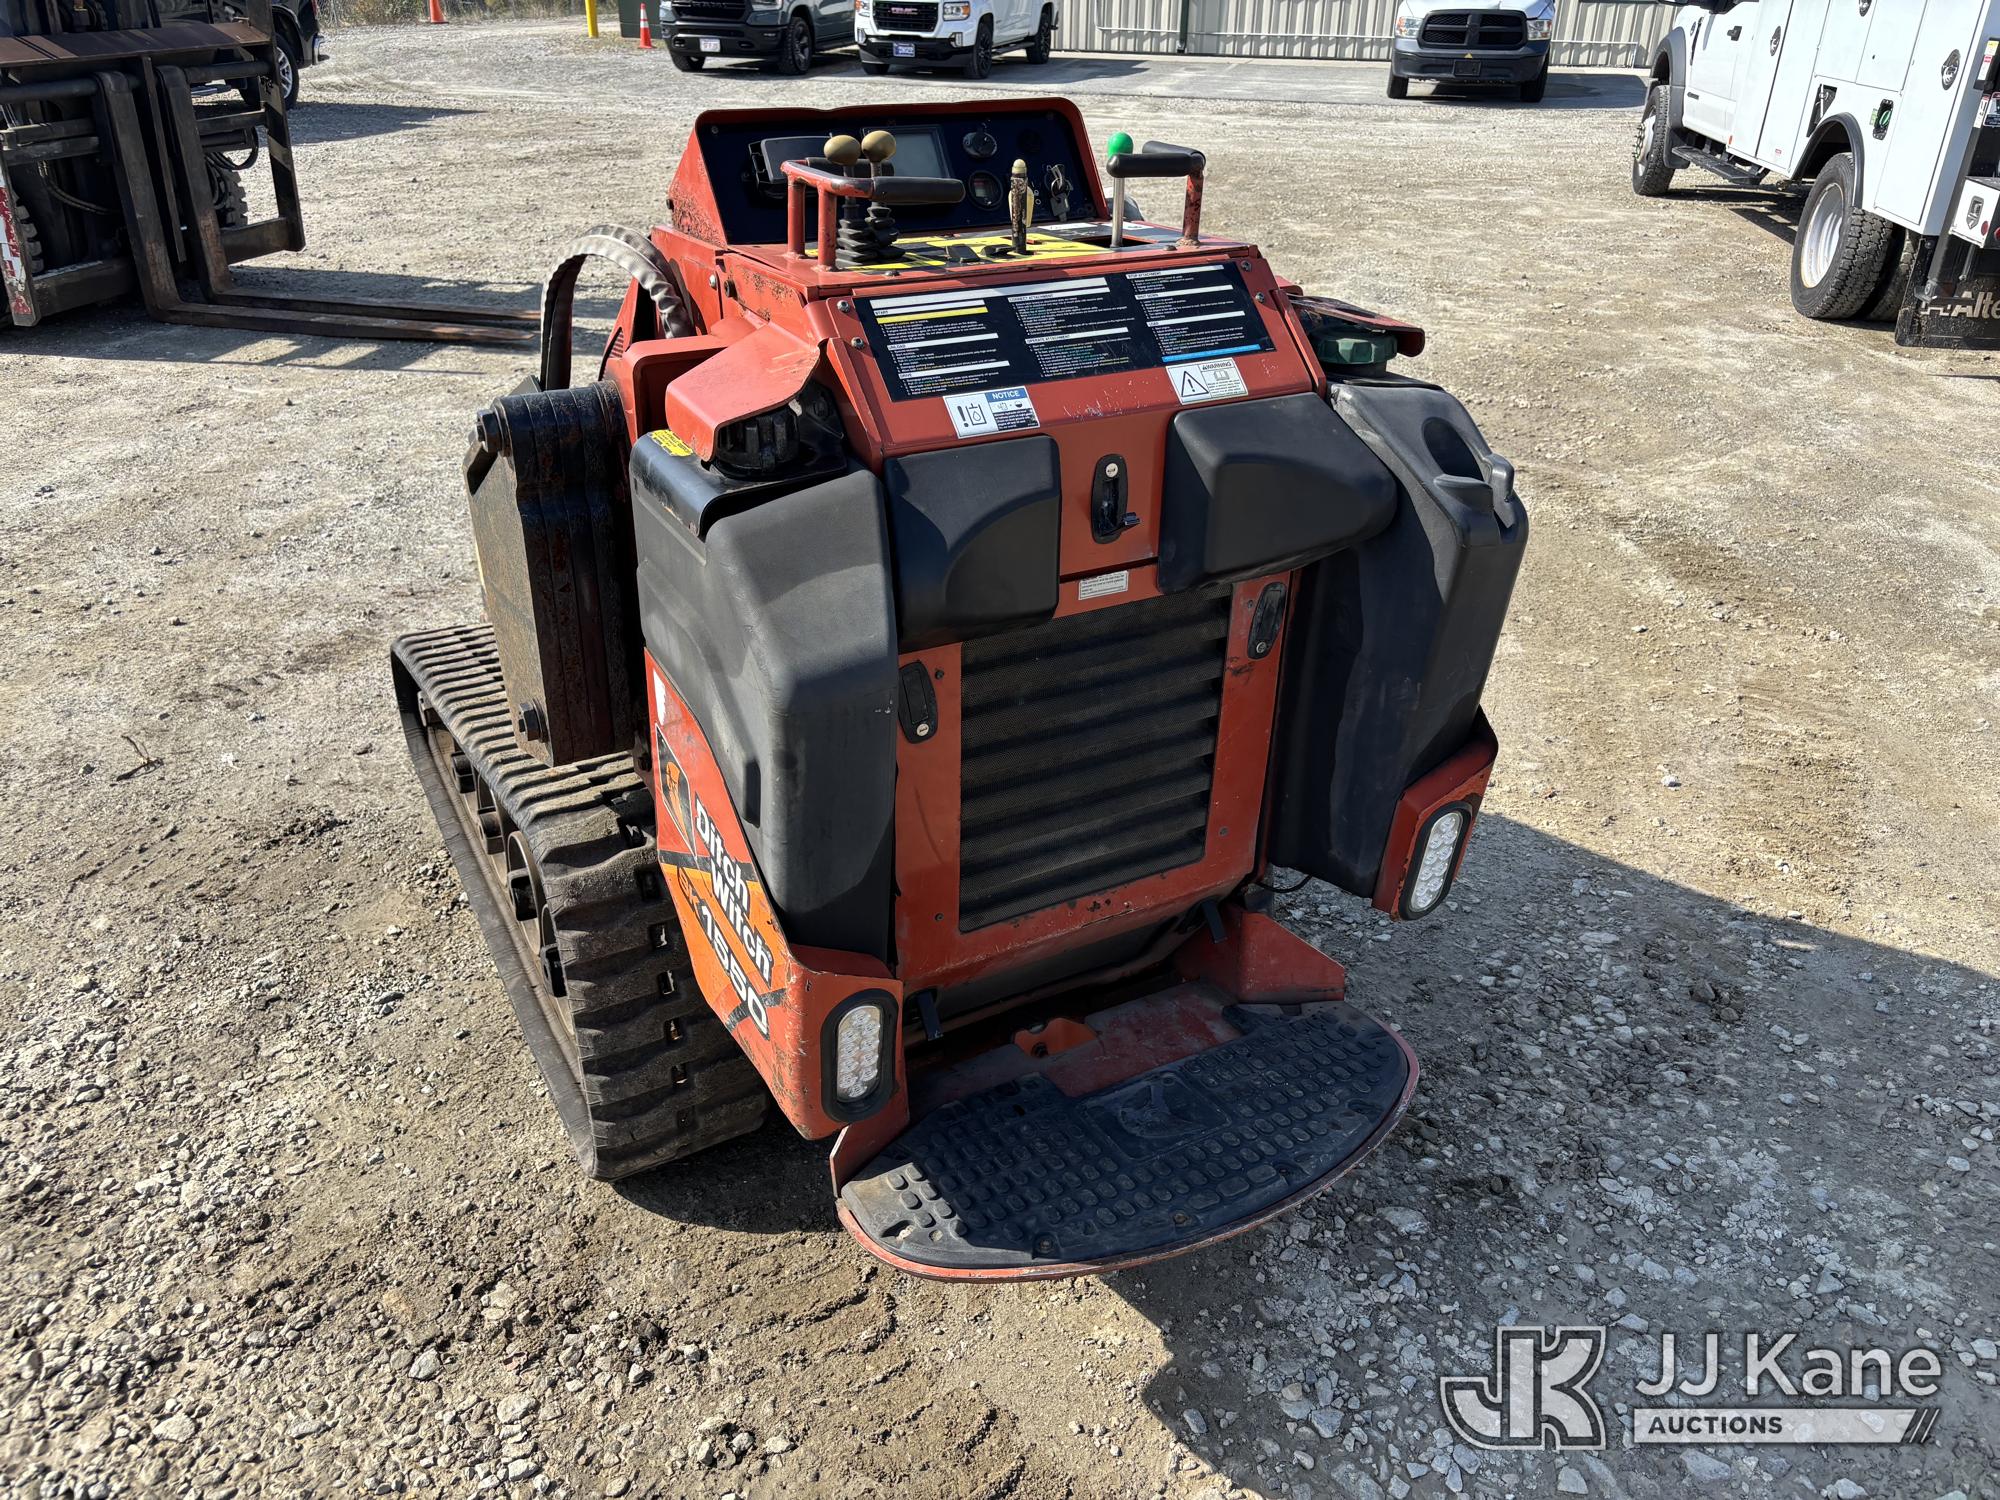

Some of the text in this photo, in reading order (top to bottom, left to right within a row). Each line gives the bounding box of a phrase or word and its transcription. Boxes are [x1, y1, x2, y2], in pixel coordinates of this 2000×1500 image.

[891, 7, 918, 15] GMC
[992, 390, 1020, 400] NOTICE
[1206, 361, 1232, 370] WARNING
[696, 797, 748, 911] Ditch
[711, 860, 771, 982] Witch
[700, 904, 769, 1036] 1550
